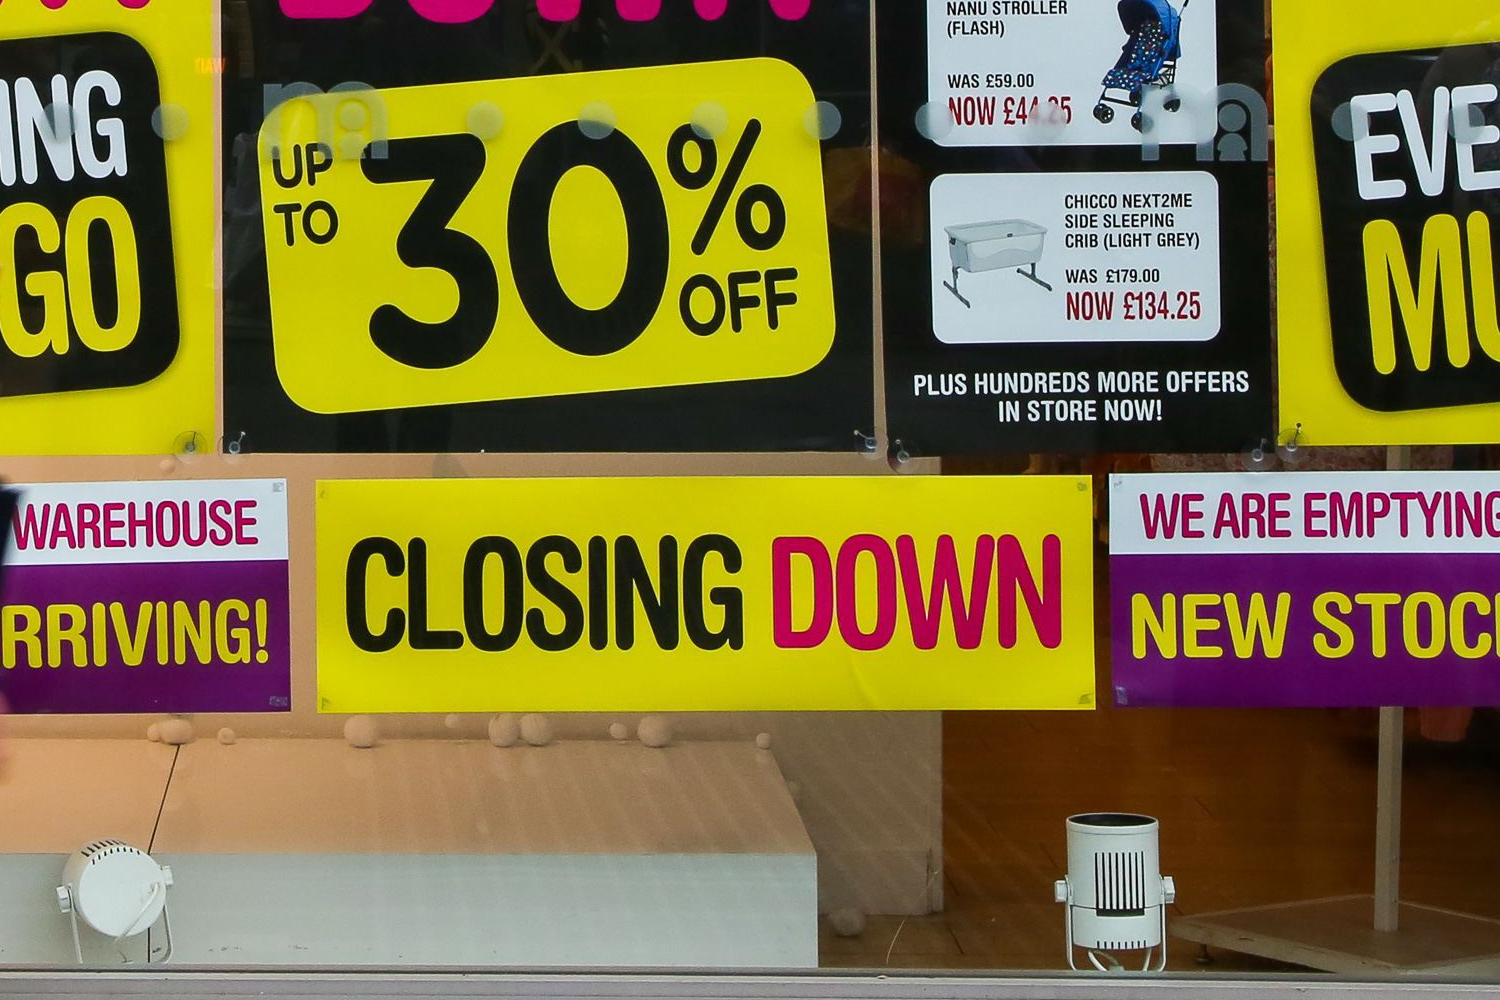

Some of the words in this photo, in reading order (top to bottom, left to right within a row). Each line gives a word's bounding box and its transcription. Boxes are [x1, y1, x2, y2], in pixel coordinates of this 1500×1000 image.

[947, 1, 987, 15] NANU
[993, 0, 1067, 15] STROLLER
[948, 20, 1004, 38] (FLASH)
[948, 74, 979, 88] WAS
[986, 74, 1034, 88] £59.00
[948, 96, 995, 126] NOW
[1003, 96, 1072, 126] £44.25
[272, 143, 333, 188] UP
[1065, 194, 1117, 209] CHICCO
[1123, 194, 1192, 208] NEXT2ME
[274, 201, 338, 246] TO
[1065, 214, 1098, 228] SIDE
[1103, 213, 1174, 228] SLEEPING
[1066, 234, 1098, 248] CRIB
[1104, 233, 1152, 251] (LIGHT
[1157, 232, 1199, 250] GREY)
[1066, 269, 1097, 283] WAS
[1106, 269, 1159, 283] £179.00
[679, 268, 798, 336] OFF
[1067, 292, 1113, 320] NOW
[1124, 291, 1200, 320] £134.25
[914, 374, 967, 396] PLUS
[975, 372, 1090, 394] HUNDREDS
[1098, 371, 1159, 392] MORE
[1167, 371, 1249, 392] OFFERS
[999, 401, 1019, 422] IN
[1028, 400, 1096, 421] STORE
[1105, 399, 1162, 421] NOW!
[11, 499, 258, 550] WAREHOUSE
[1140, 493, 1204, 539] WE
[1213, 493, 1291, 538] ARE
[346, 533, 743, 652] CLOSING
[772, 534, 1062, 651] DOWN
[1132, 592, 1291, 659] NEW
[1313, 592, 1500, 658] STOC
